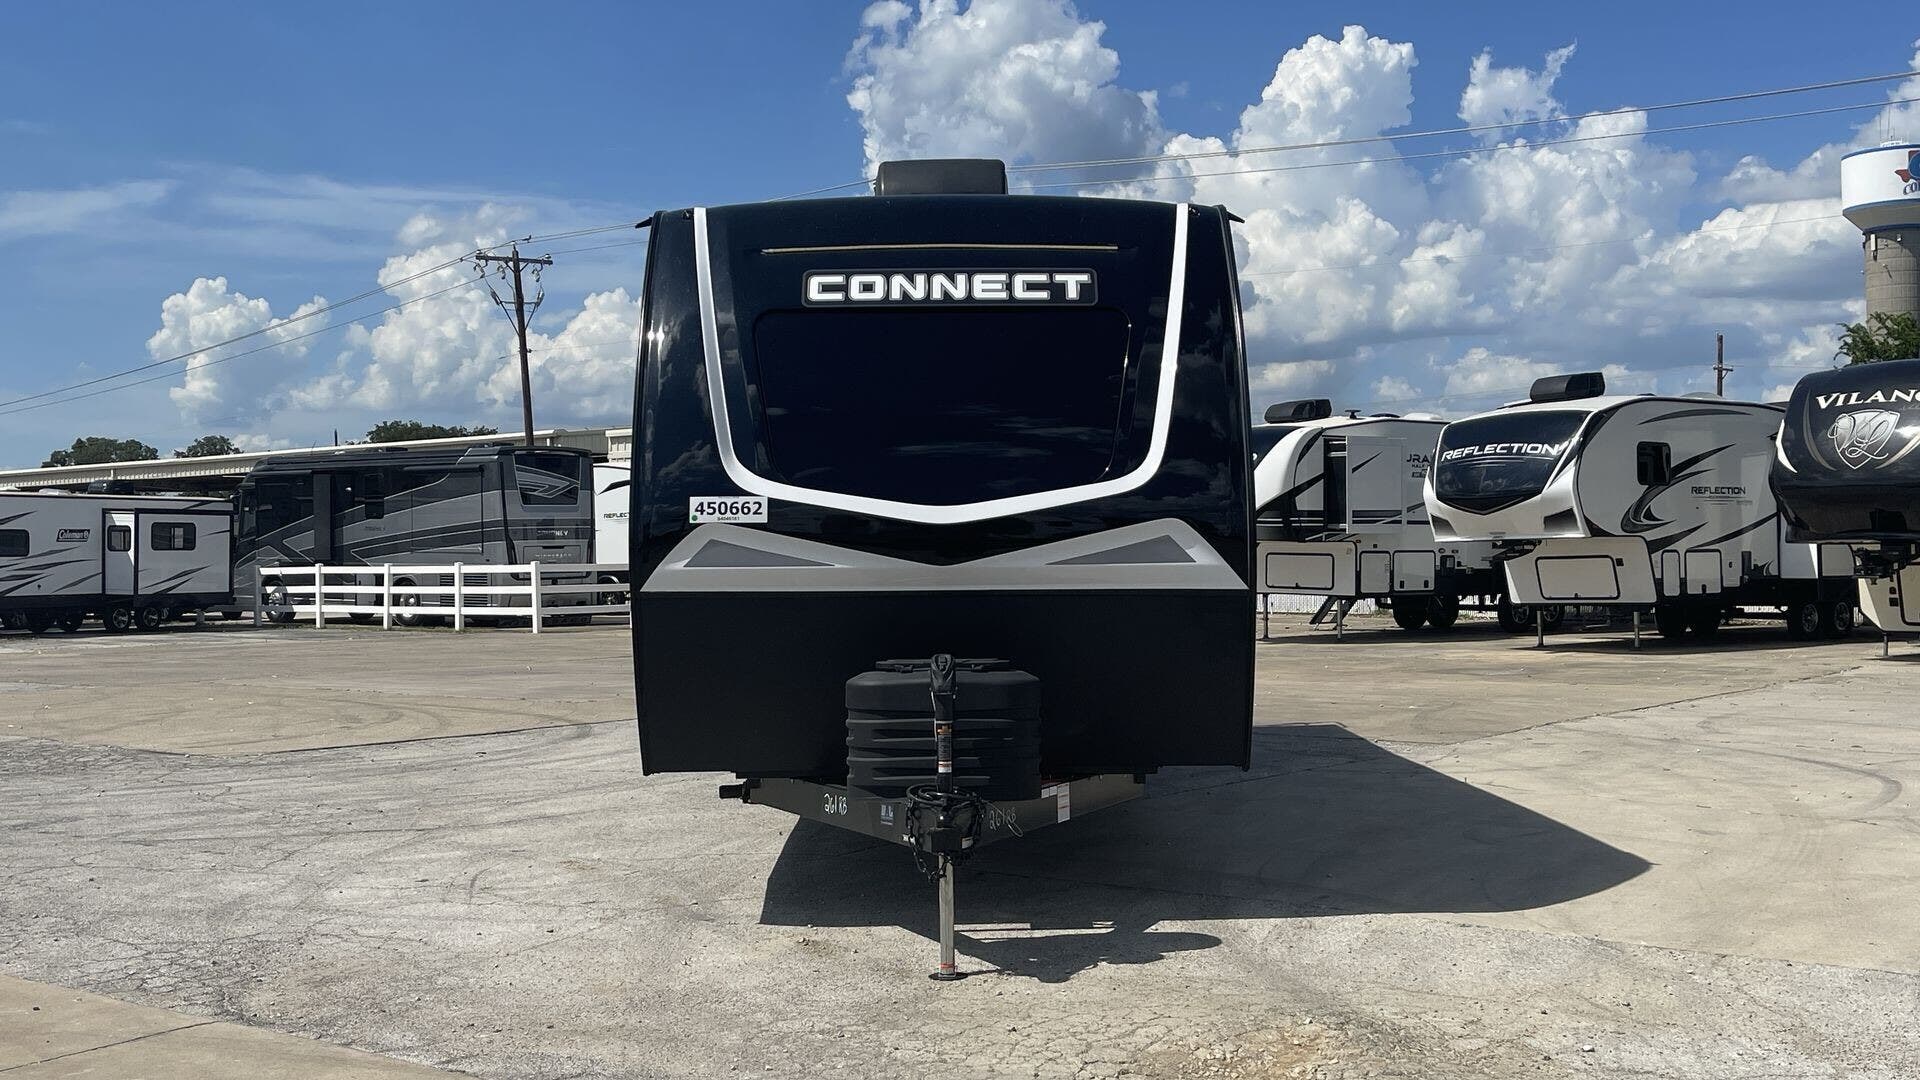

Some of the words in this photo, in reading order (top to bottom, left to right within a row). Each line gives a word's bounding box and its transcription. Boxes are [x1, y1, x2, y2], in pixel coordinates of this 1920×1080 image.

[807, 274, 1092, 300] CONNECT
[1441, 443, 1560, 461] REFLECTION
[1691, 486, 1746, 495] REFLECTION
[694, 501, 763, 516] 450662
